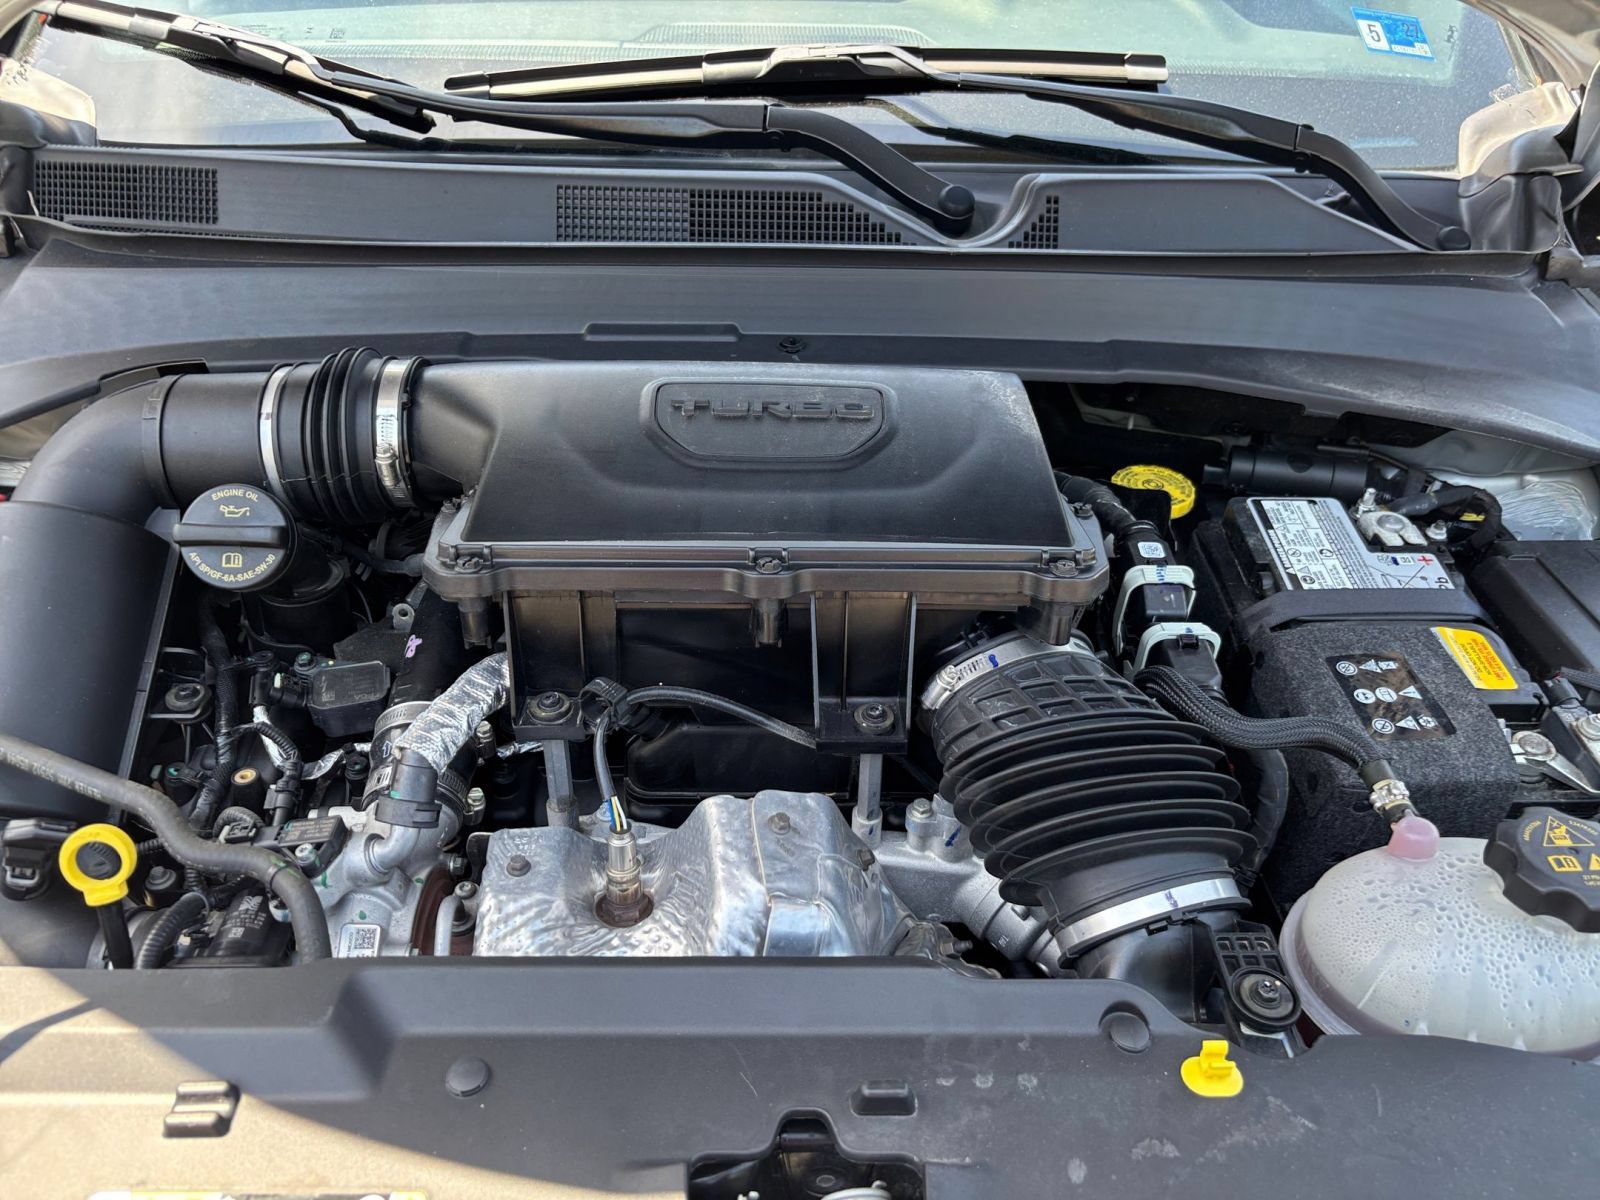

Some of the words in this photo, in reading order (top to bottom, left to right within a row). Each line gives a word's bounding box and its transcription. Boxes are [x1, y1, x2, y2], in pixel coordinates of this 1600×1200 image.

[1367, 23, 1381, 43] 5
[211, 489, 244, 501] ENGINE
[245, 492, 259, 502] OIL
[189, 552, 202, 566] API
